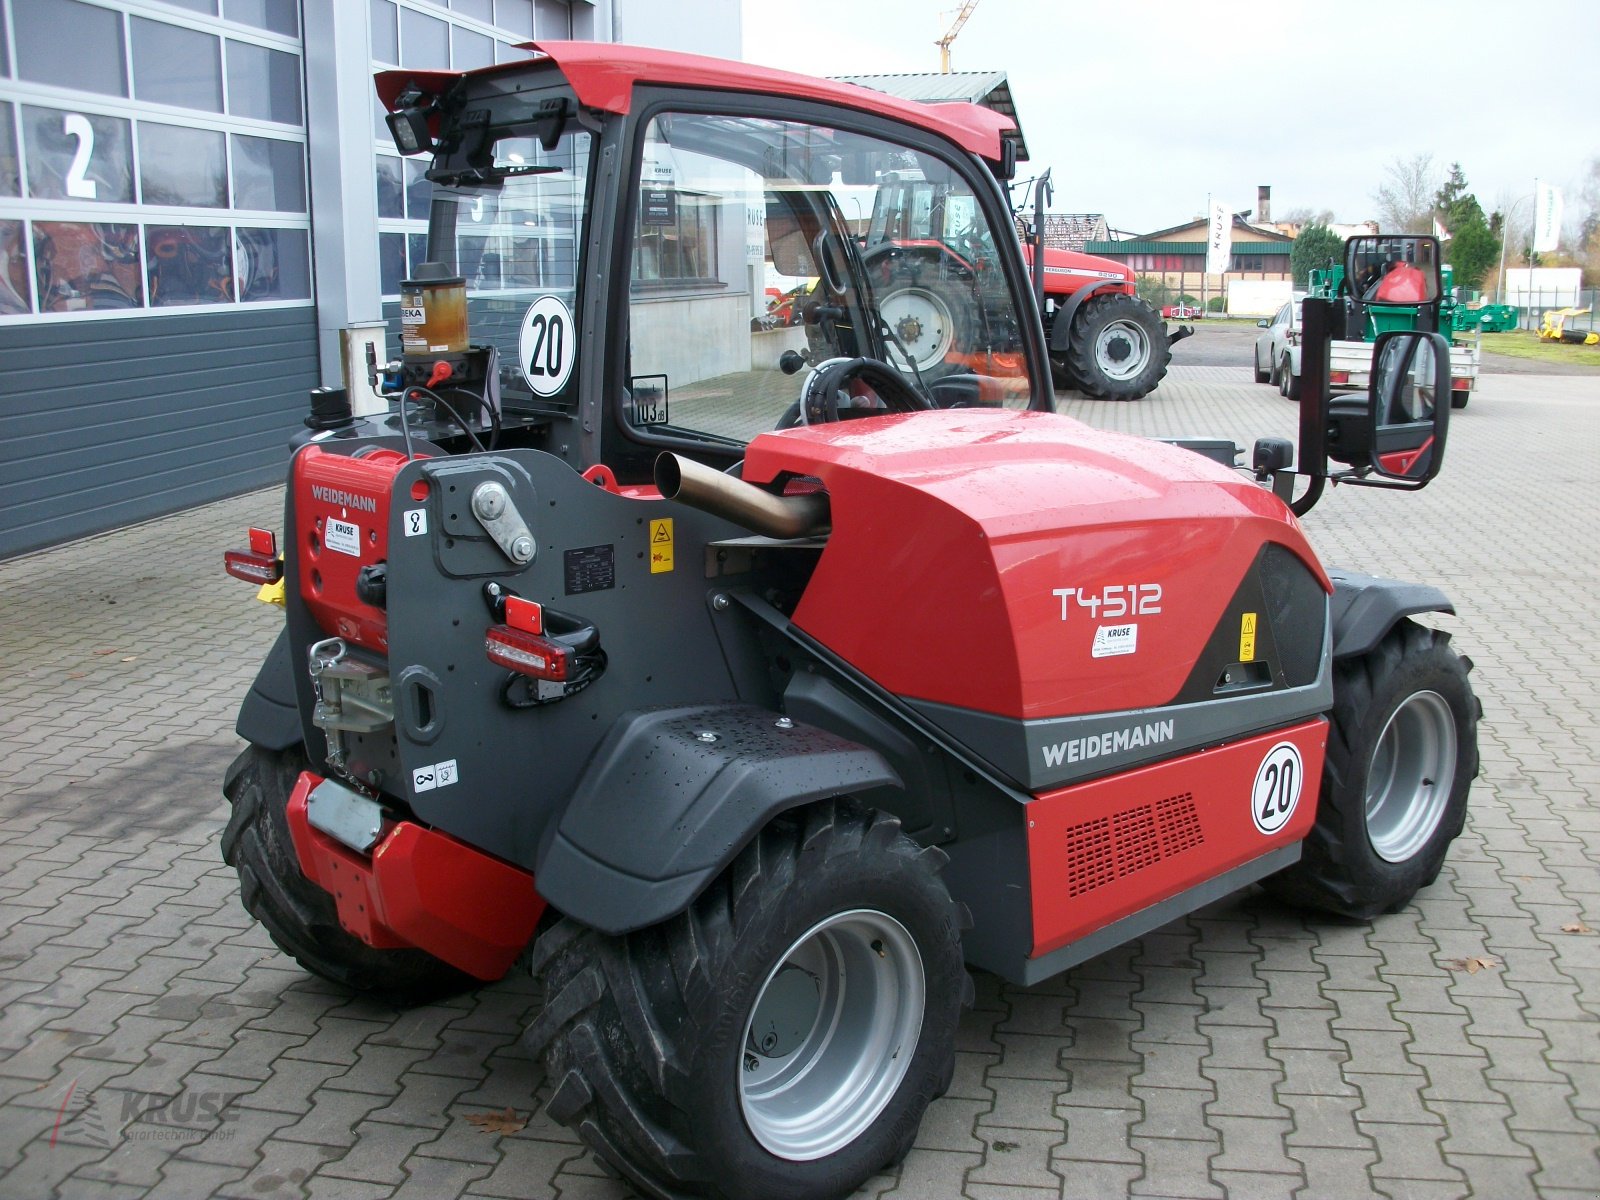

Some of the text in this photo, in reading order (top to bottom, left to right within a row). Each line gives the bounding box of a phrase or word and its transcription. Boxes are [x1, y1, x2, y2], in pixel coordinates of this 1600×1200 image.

[65, 113, 97, 199] 2
[529, 313, 564, 377] 20
[312, 484, 376, 513] WEIDEMANN
[335, 523, 354, 536] KRUSE
[1052, 583, 1162, 621] T4512
[1107, 627, 1131, 638] KRUSE
[1042, 719, 1174, 768] WEIDEMANN
[1261, 758, 1294, 820] 20
